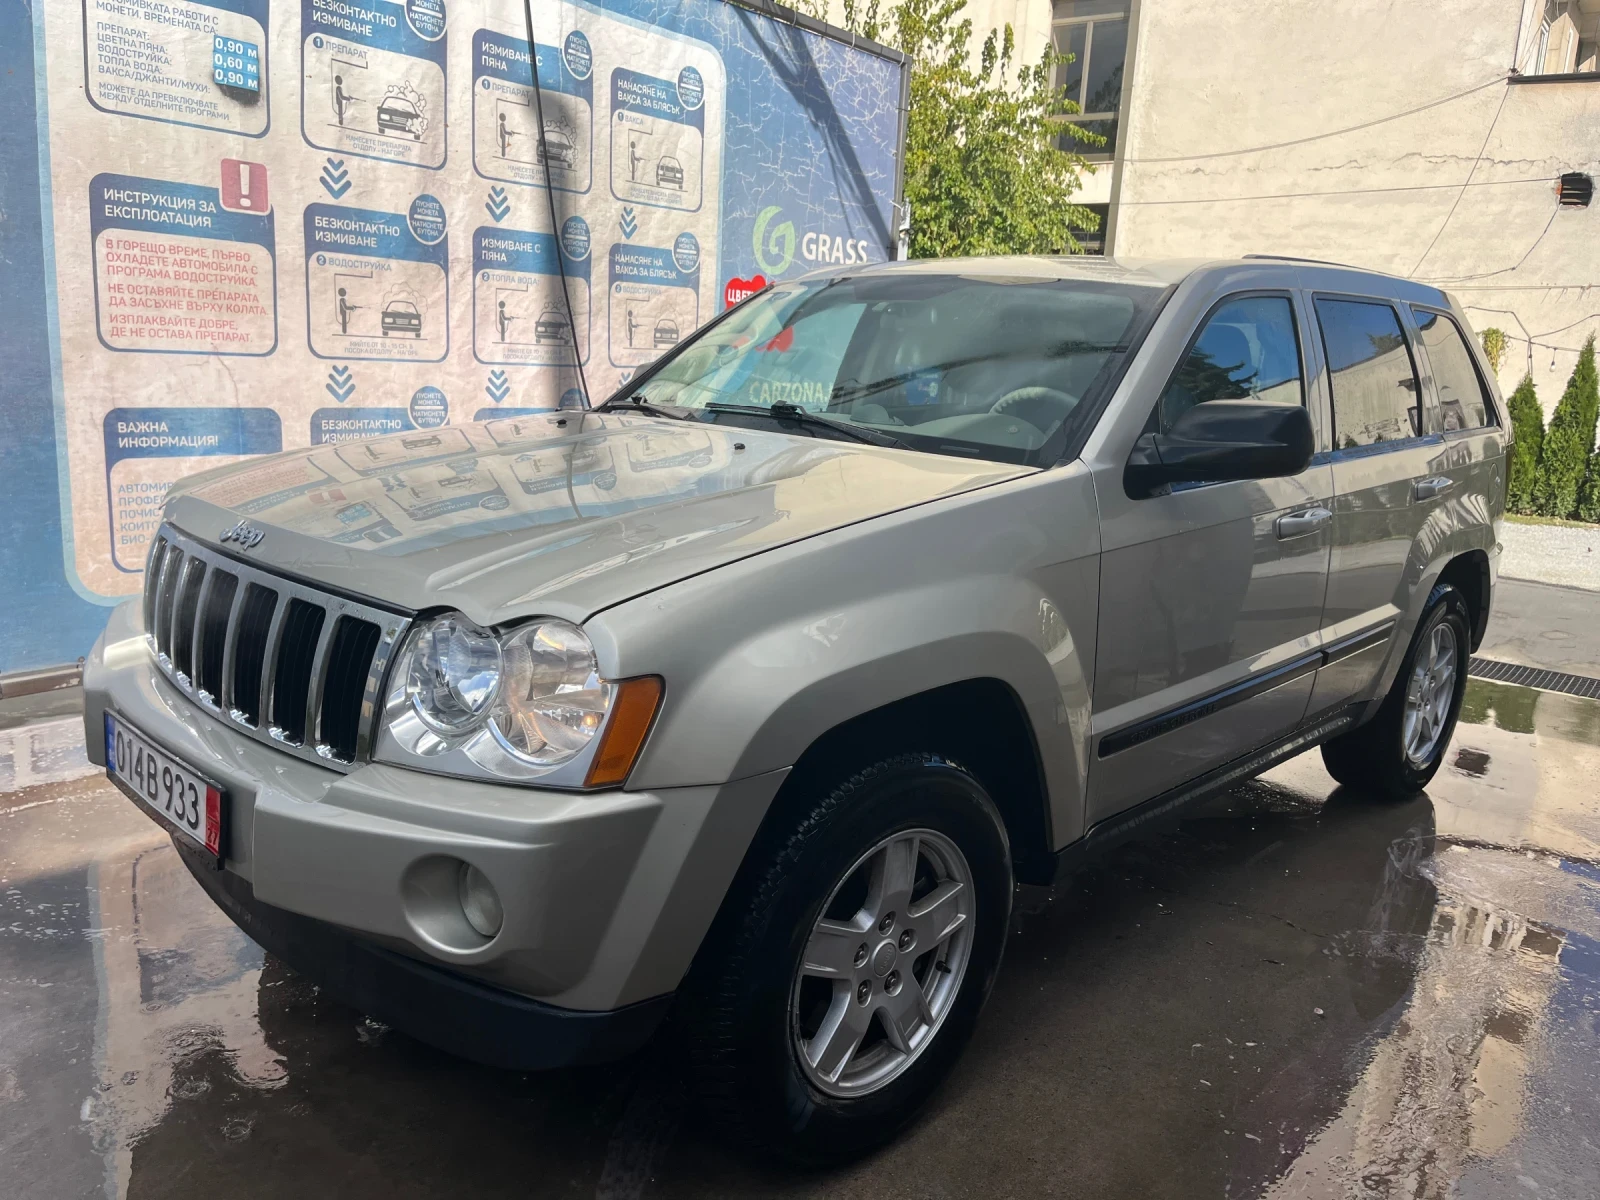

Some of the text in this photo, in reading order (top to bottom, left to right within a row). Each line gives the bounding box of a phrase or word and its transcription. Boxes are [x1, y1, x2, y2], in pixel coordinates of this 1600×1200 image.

[144, 13, 201, 31] ВРЕМЕНАТА
[173, 8, 211, 23] РАБОТИ
[213, 17, 218, 25] С
[312, 0, 397, 28] БЕЗКОНТАКТНО
[409, 11, 444, 27] НАТИСНЕТЕ
[97, 22, 150, 40] ПРЕПАРАТ:
[312, 10, 373, 37] ИЗМИВАНЕ
[415, 20, 440, 33] БУТОНА
[97, 33, 168, 55] ЦВЕТНА ПЯНА:
[214, 38, 243, 55] 0,90
[325, 41, 368, 60] ПРЕПАРАТ
[97, 44, 172, 66] ВОДОСТРУЙКА:
[214, 54, 243, 70] 0,60
[481, 55, 508, 72] ПЯНА
[536, 56, 543, 67] С
[97, 54, 163, 75] ТОПЛА ВОДА:
[98, 65, 211, 94] ВАКСА/ДЖАНТИ/МУХИ:
[214, 69, 243, 85] 0,90
[98, 82, 218, 111] МОЖЕТЕ ДА ПРЕВКЛЮЧВАТЕ
[492, 83, 530, 98] ПРЕПАРАТ
[617, 78, 667, 100] НАНАСЯНЕ НА
[99, 91, 229, 121] МЕЖДУ ОТДЕЛНИТЕ ПРОГРАМИ
[617, 90, 681, 116] ВАКСА ЗА БЛЯСЪК
[625, 115, 644, 125] ВАКСА
[104, 187, 217, 213] ИНСТРУКЦИЯ ЗА
[105, 204, 212, 228] ЕКСПЛОАТАЦИЯ
[314, 215, 400, 237] БЕЗКОНТАКТНО
[315, 230, 378, 248] ИЗМИВАНЕ
[481, 237, 541, 254] ИЗМИВАНЕ С
[801, 231, 868, 264] GRASS
[105, 238, 250, 263] В ГОРЕЩО ВРЕМЕ, ПЪРВО
[481, 250, 508, 263] ПЯНА
[106, 252, 258, 275] ОХЛАДЕТЕ АВТОМОБИЛА С
[328, 257, 393, 272] ВОДОСТРУЙКА
[614, 253, 663, 267] НАНАСЯНЕ НА
[107, 265, 258, 287] ПРОГРАМА ВОДОСТРУЙКА.
[491, 274, 516, 283] ТОПЛА
[615, 265, 677, 279] ВАКСА ЗА БЛЯСЪК
[108, 283, 259, 303] НЕ ОСТАВЯЙТЕ ПРЕПАРАТА
[108, 296, 127, 307] ДА
[129, 297, 184, 310] ЗАСЪХНЕ
[186, 301, 223, 314] ВЪРХУ
[109, 313, 238, 331] ИЗПЛАКВАЙТЕ ДОБРЕ,
[130, 327, 146, 337] НЕ
[149, 328, 192, 339] ОСТАВА
[195, 331, 253, 343] ПРЕПАРАТ.
[117, 421, 169, 433] ВАЖНА
[321, 419, 402, 430] БЕЗКОНТАКТНО
[118, 435, 219, 449] ИНФОРМАЦИЯ!
[119, 508, 163, 519] ПОЧИС
[219, 519, 266, 551] Jeep
